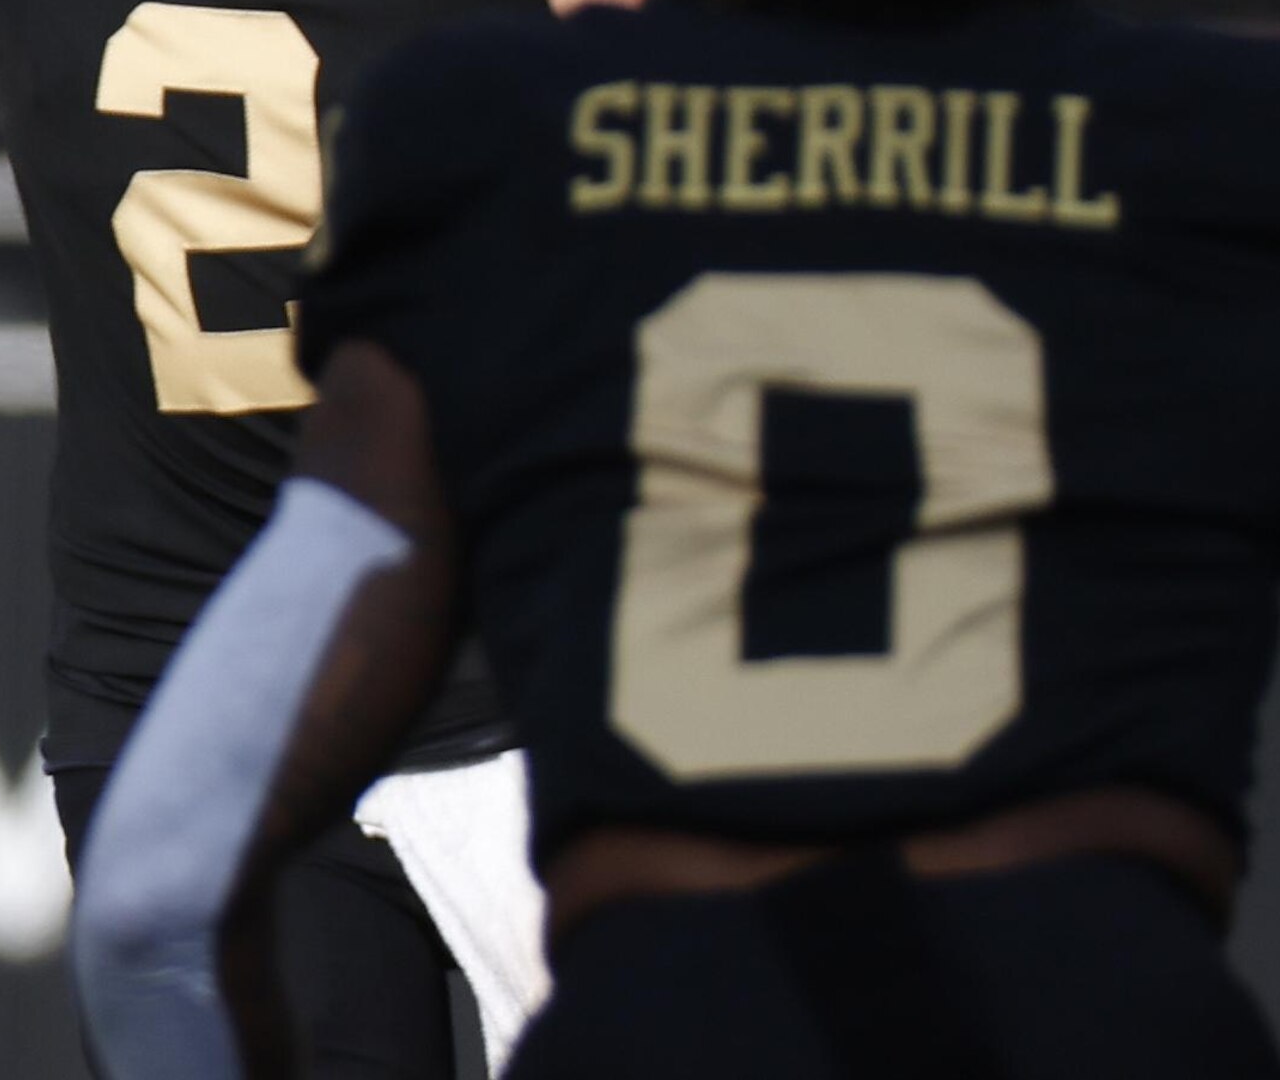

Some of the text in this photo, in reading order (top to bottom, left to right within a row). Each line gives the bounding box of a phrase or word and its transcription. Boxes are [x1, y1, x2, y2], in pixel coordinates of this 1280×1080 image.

[96, 1, 321, 415] 2
[570, 80, 1120, 228] SHERRILL
[609, 270, 1056, 785] 0
